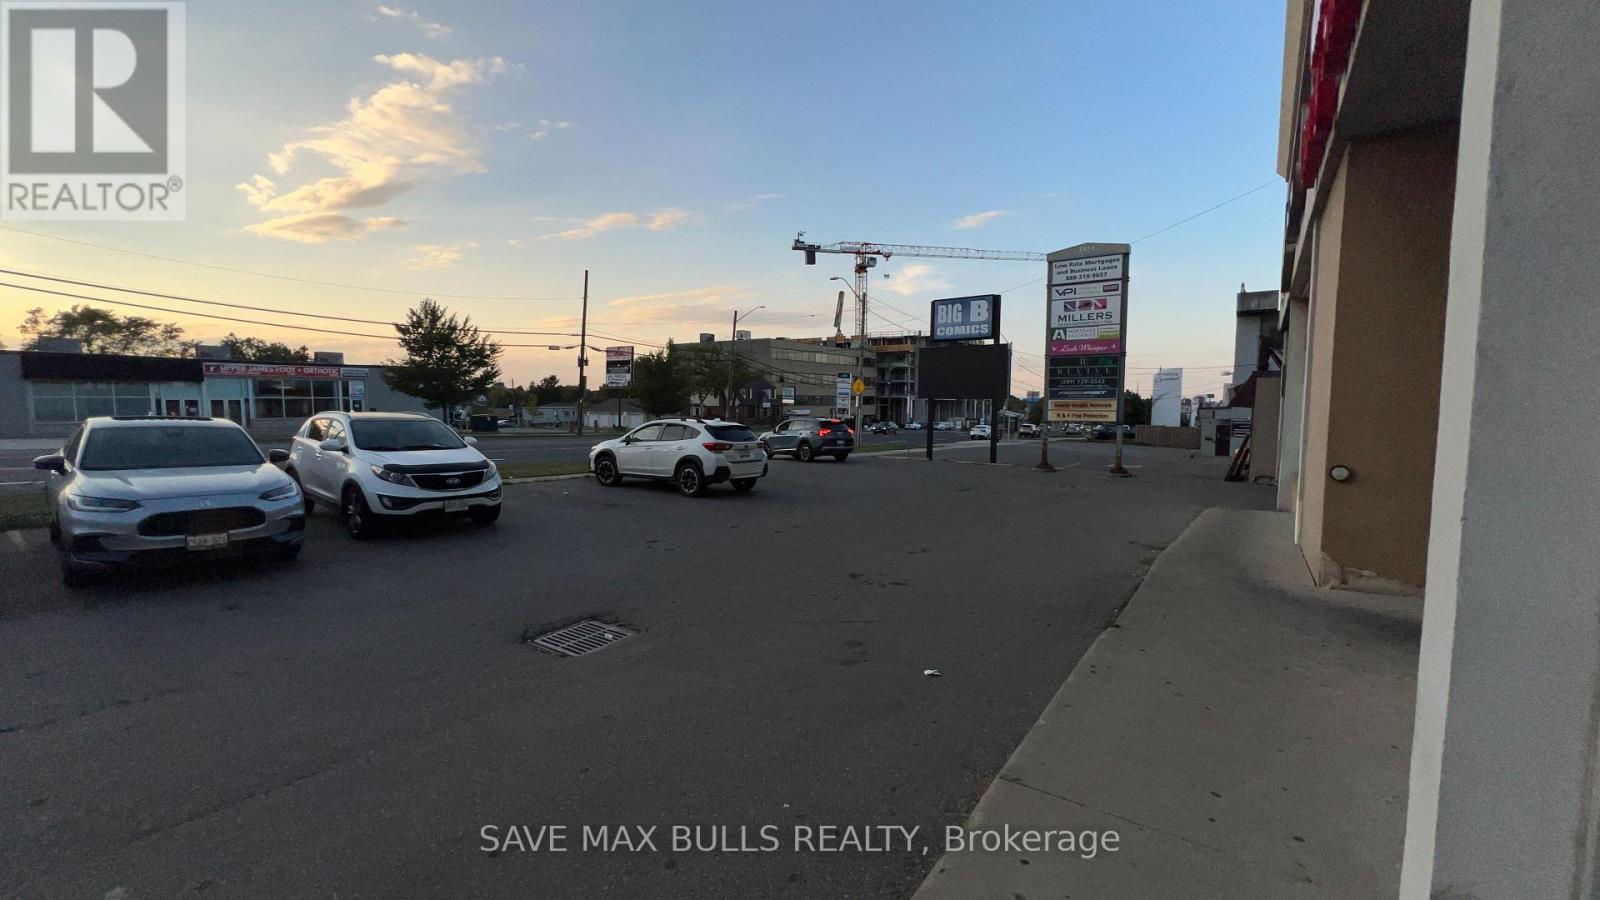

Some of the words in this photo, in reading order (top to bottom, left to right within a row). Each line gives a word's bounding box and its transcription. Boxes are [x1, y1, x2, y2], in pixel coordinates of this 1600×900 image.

[1084, 258, 1120, 266] Mortgages
[1055, 287, 1077, 296] VPI
[937, 303, 962, 324] BIG
[970, 300, 989, 322] B
[1058, 312, 1113, 323] MILLERS
[936, 324, 989, 336] COMICS
